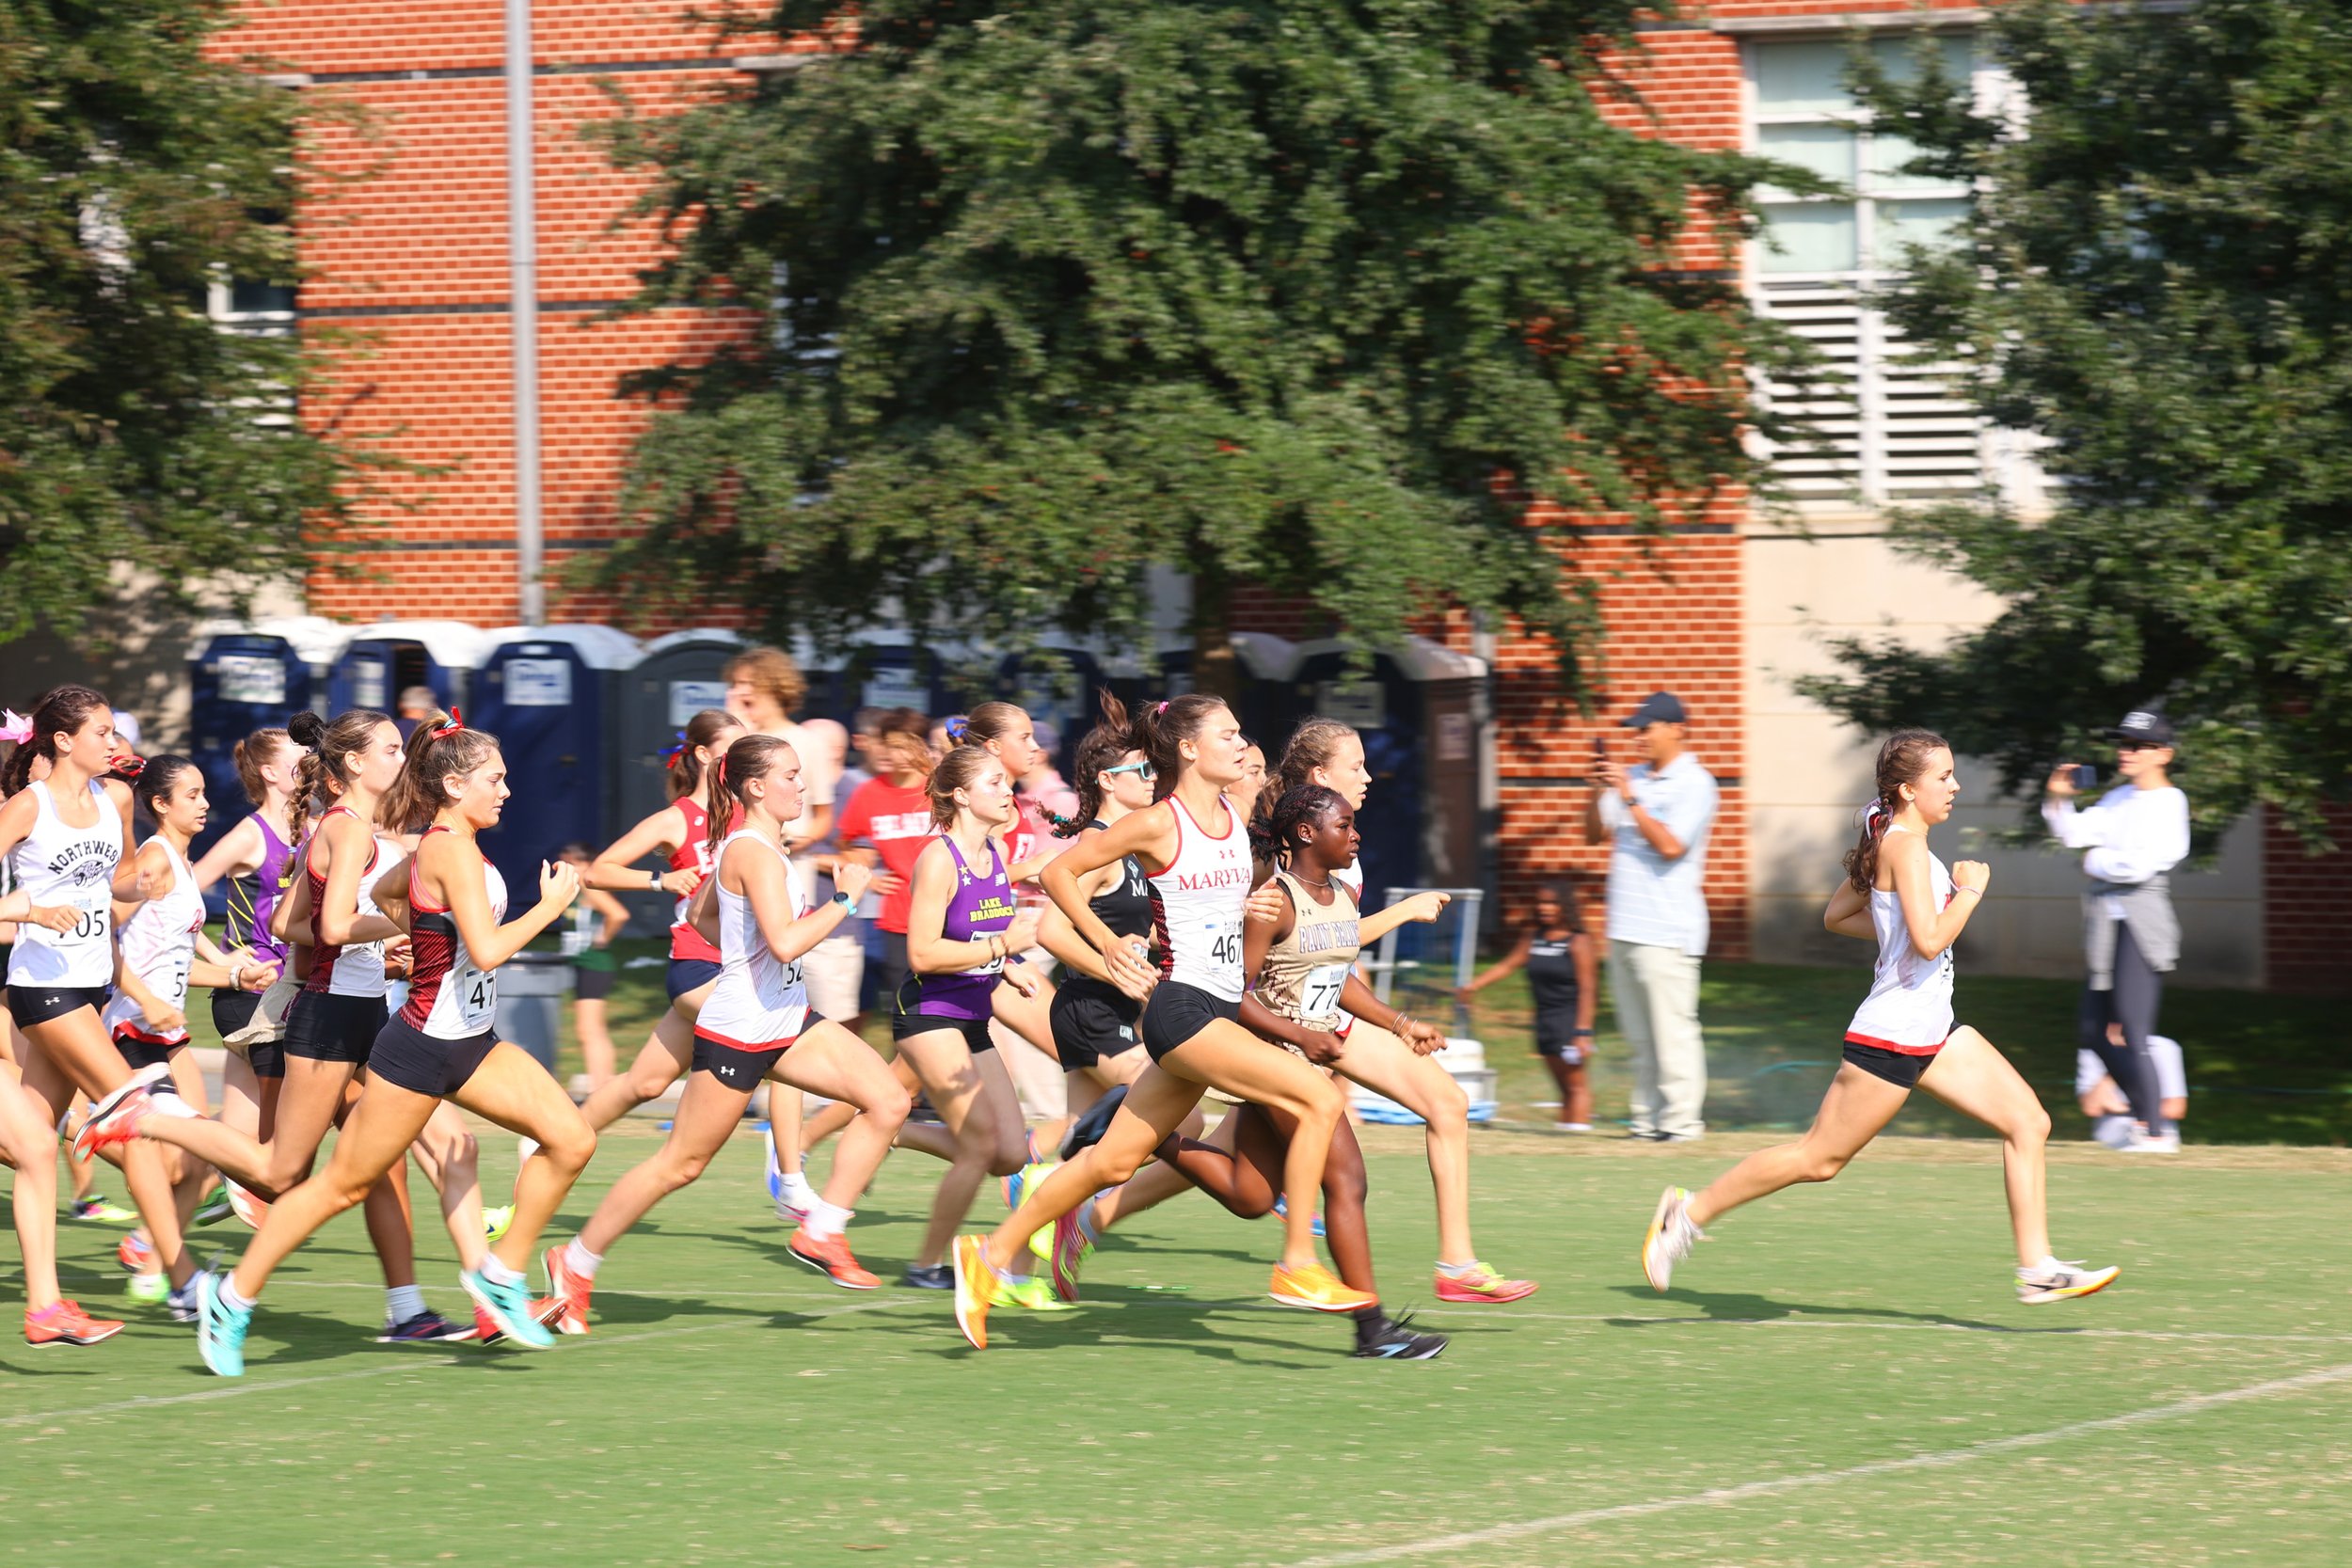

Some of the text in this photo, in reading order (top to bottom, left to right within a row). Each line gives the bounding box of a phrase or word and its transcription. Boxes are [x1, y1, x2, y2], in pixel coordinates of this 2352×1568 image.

[47, 840, 120, 875] NORTHWES
[1177, 866, 1252, 891] MARYVA
[969, 906, 1015, 922] BRADDOCK
[978, 896, 1003, 910] LAKE
[59, 910, 104, 939] 05
[1298, 922, 1333, 954] PAINT
[1212, 934, 1242, 964] 467
[787, 961, 803, 985] 52
[470, 976, 497, 1010] 47
